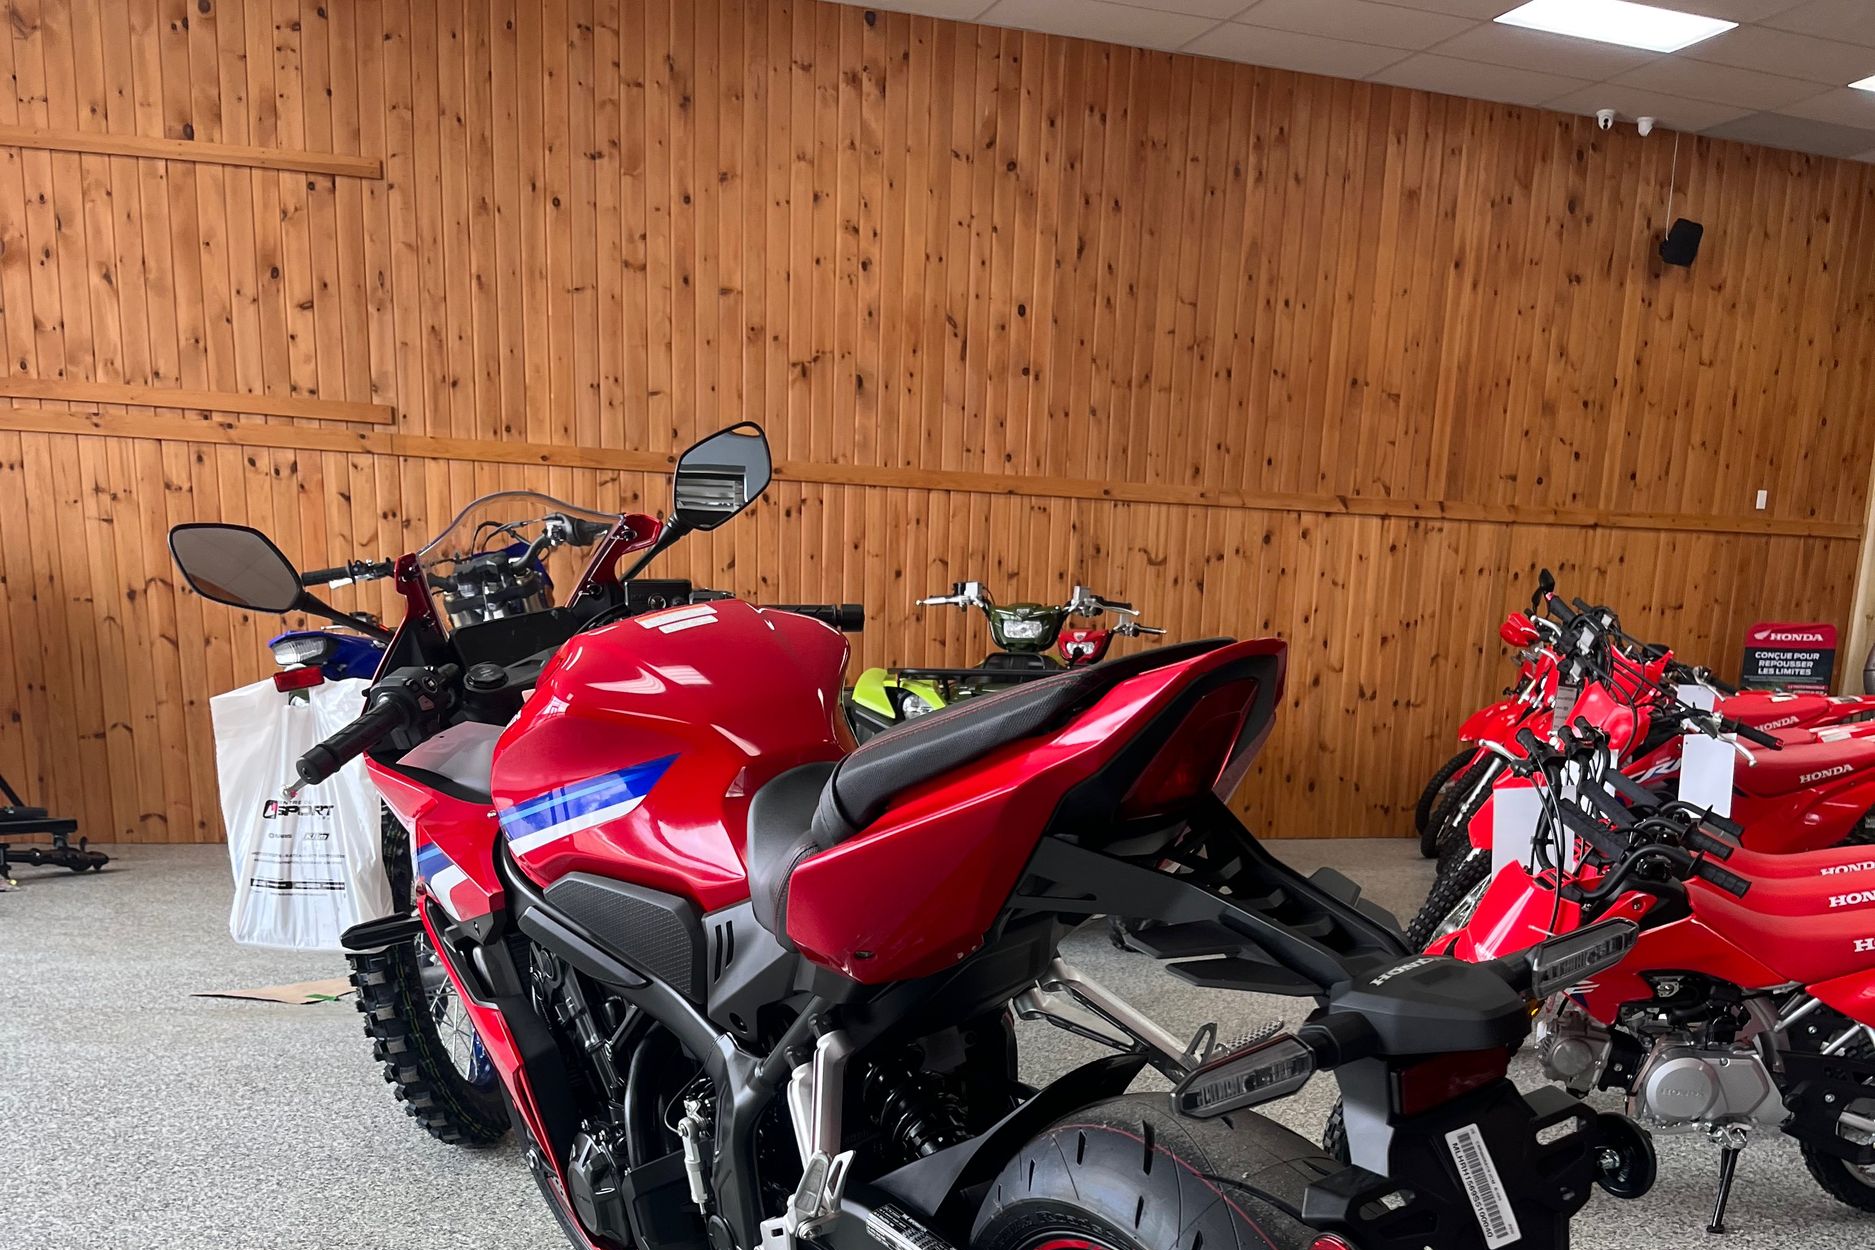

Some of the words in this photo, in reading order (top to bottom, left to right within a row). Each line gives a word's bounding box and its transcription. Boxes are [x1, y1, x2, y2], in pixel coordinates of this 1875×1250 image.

[1770, 632, 1823, 642] HONDA
[1755, 651, 1793, 660] CONÇUE
[1794, 652, 1820, 660] POUR
[1758, 660, 1814, 668] REPOUSSER
[1800, 764, 1854, 784] HONDA
[1820, 860, 1875, 876] HOND
[1829, 890, 1875, 908] HON
[1369, 956, 1438, 987] HOND
